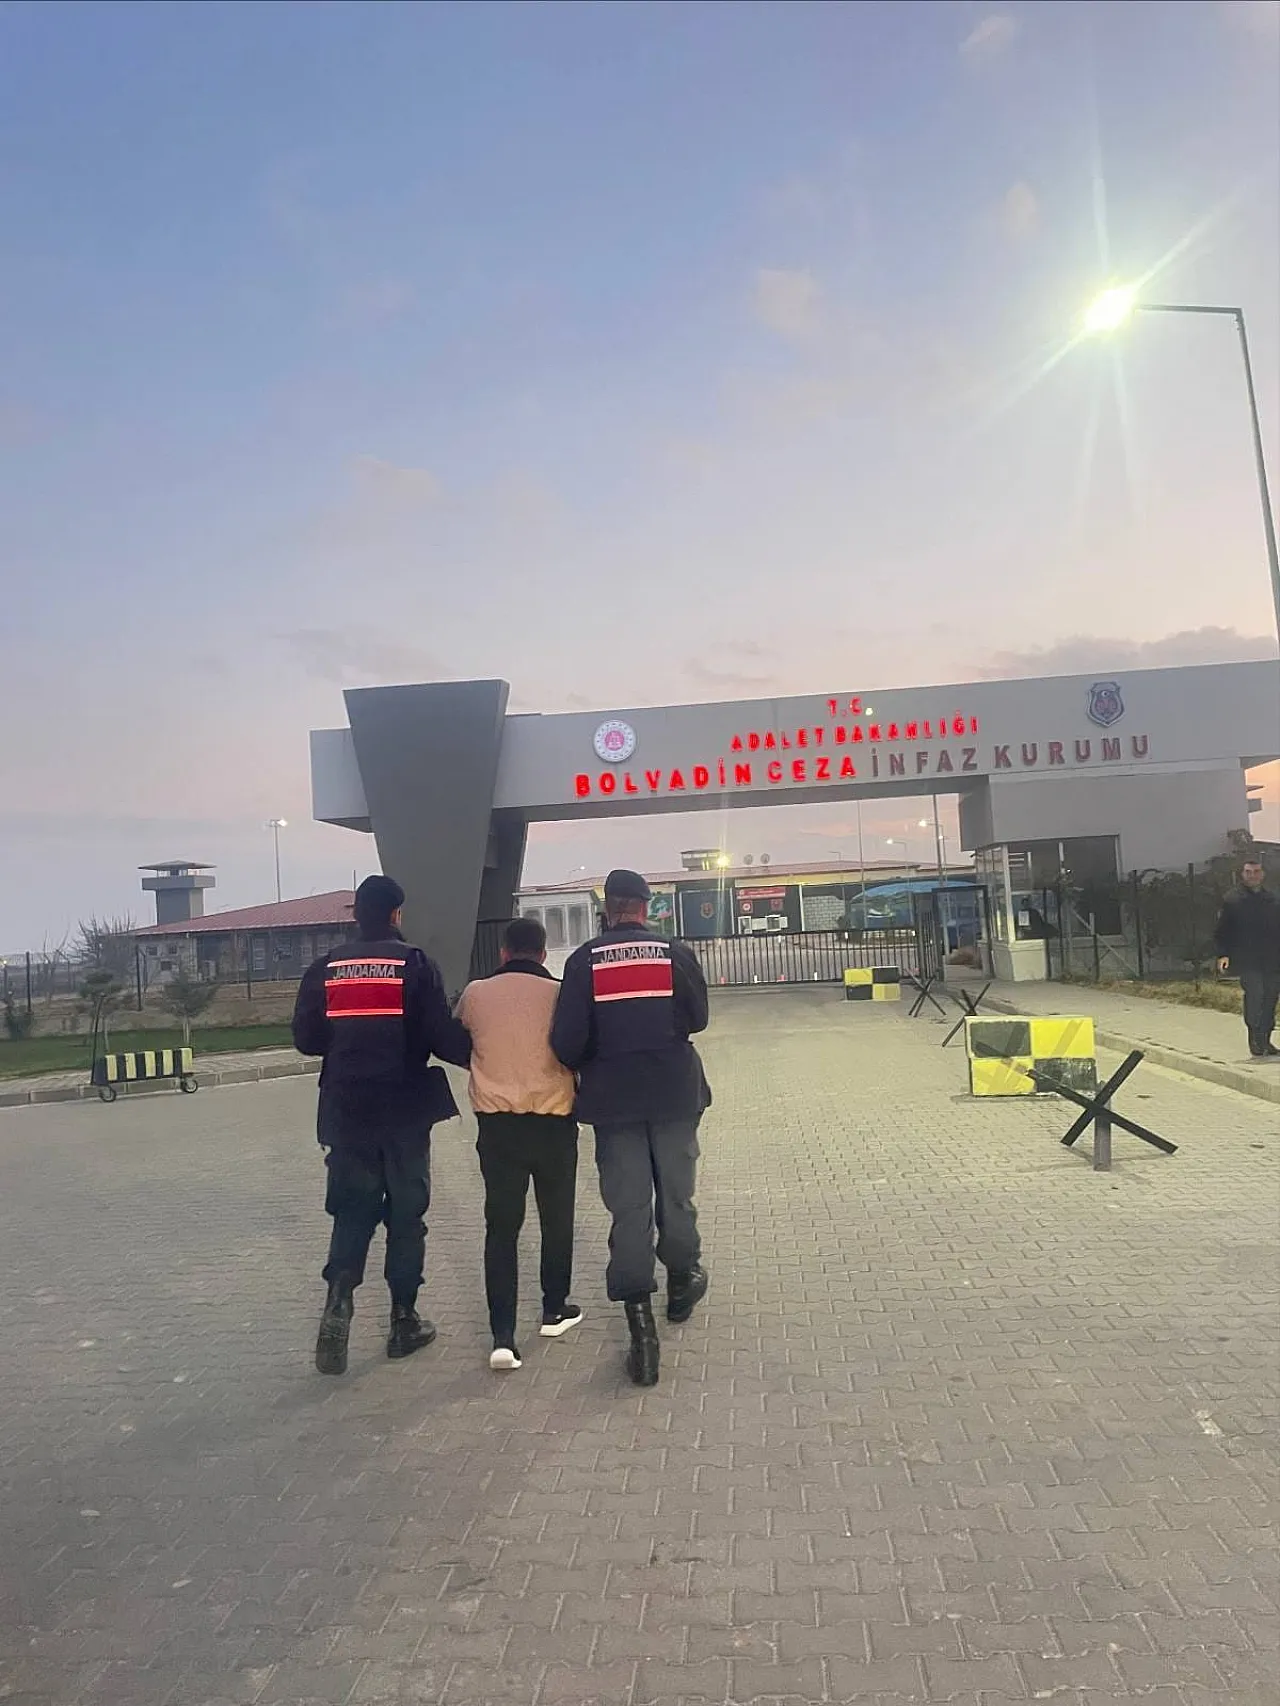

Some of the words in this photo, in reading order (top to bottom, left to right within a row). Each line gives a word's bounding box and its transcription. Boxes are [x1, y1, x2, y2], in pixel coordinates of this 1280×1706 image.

[731, 727, 825, 753] ADALET
[834, 710, 979, 743] BAKANLIĞI
[575, 757, 752, 798] BOLVADİN
[767, 755, 857, 784] CEZA
[871, 747, 978, 777] İNFAZ
[994, 733, 1150, 769] KURUMU
[600, 946, 665, 964] JANDARMA
[333, 964, 396, 981] JANDARMA
